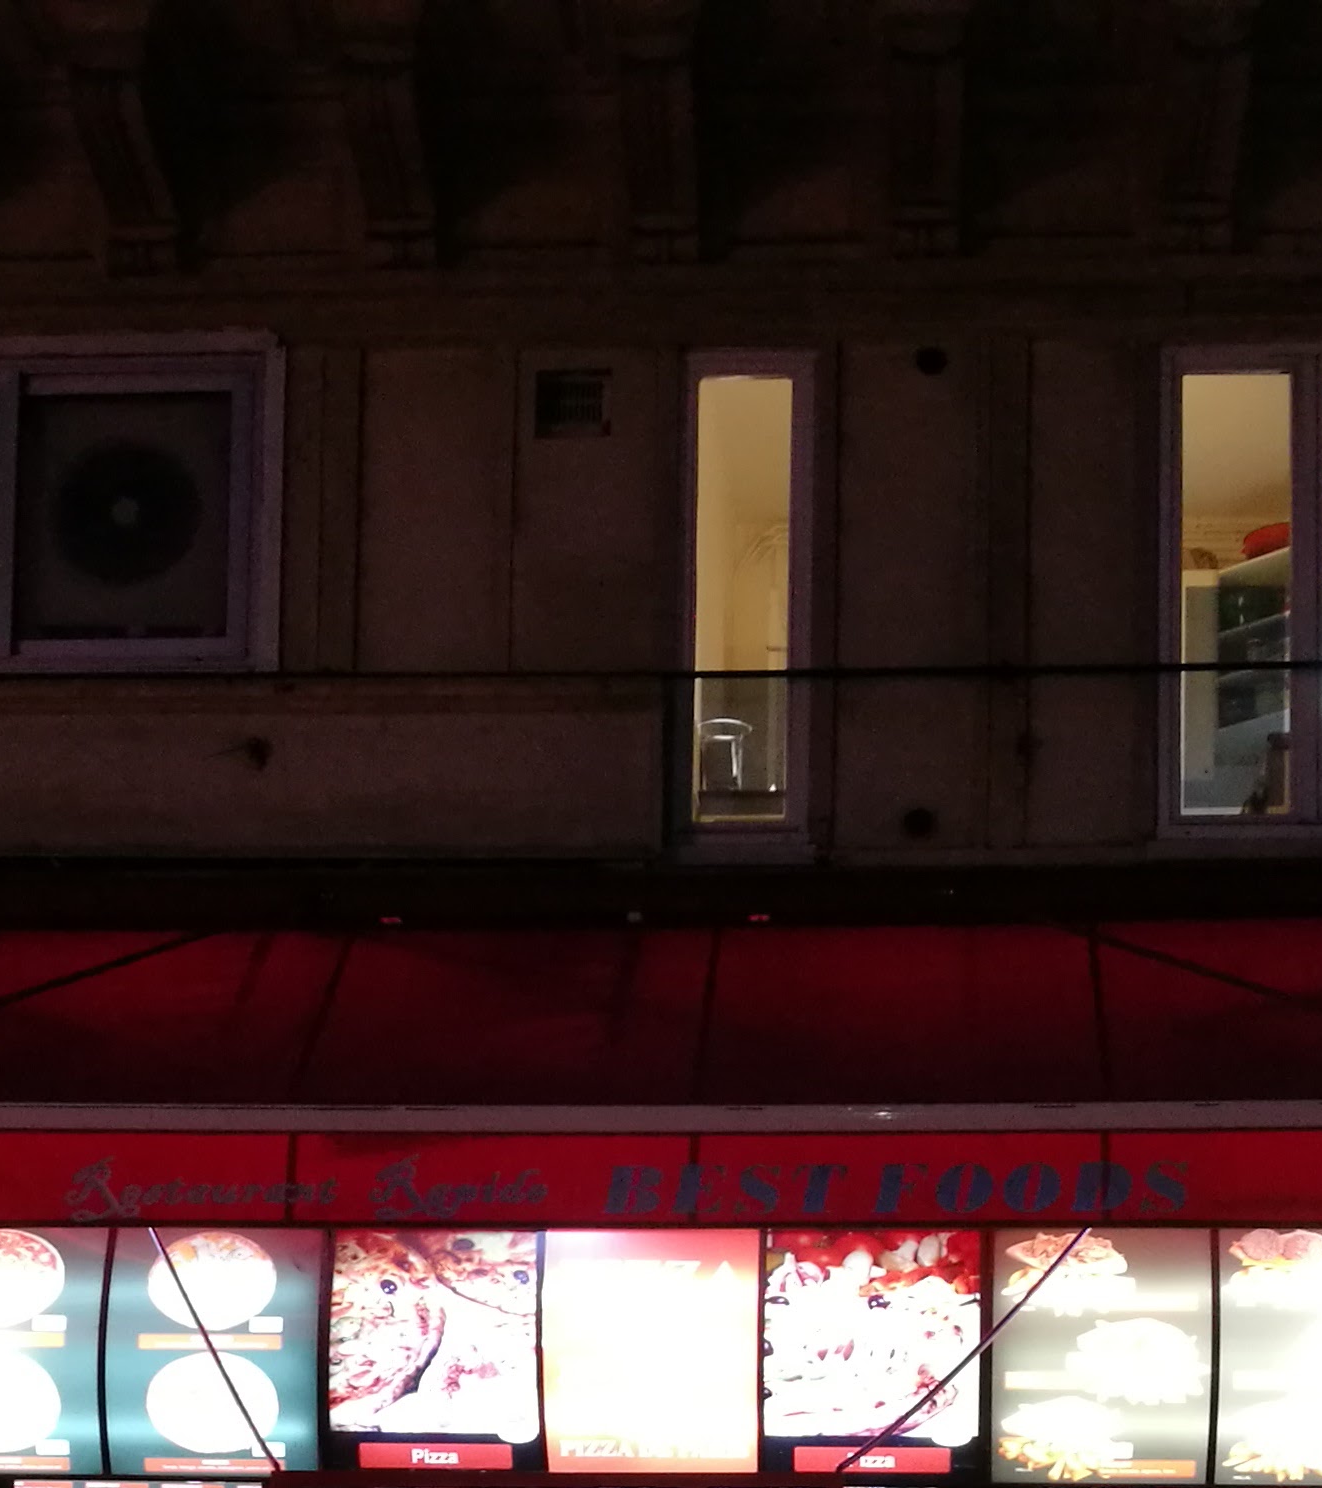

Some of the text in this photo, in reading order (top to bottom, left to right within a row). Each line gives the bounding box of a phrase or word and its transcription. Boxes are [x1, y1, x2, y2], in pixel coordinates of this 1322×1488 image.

[64, 1153, 1192, 1223] Restaurant Rapide BEST FOODS
[411, 1447, 460, 1465] Pizza
[846, 1451, 896, 1469] izza
